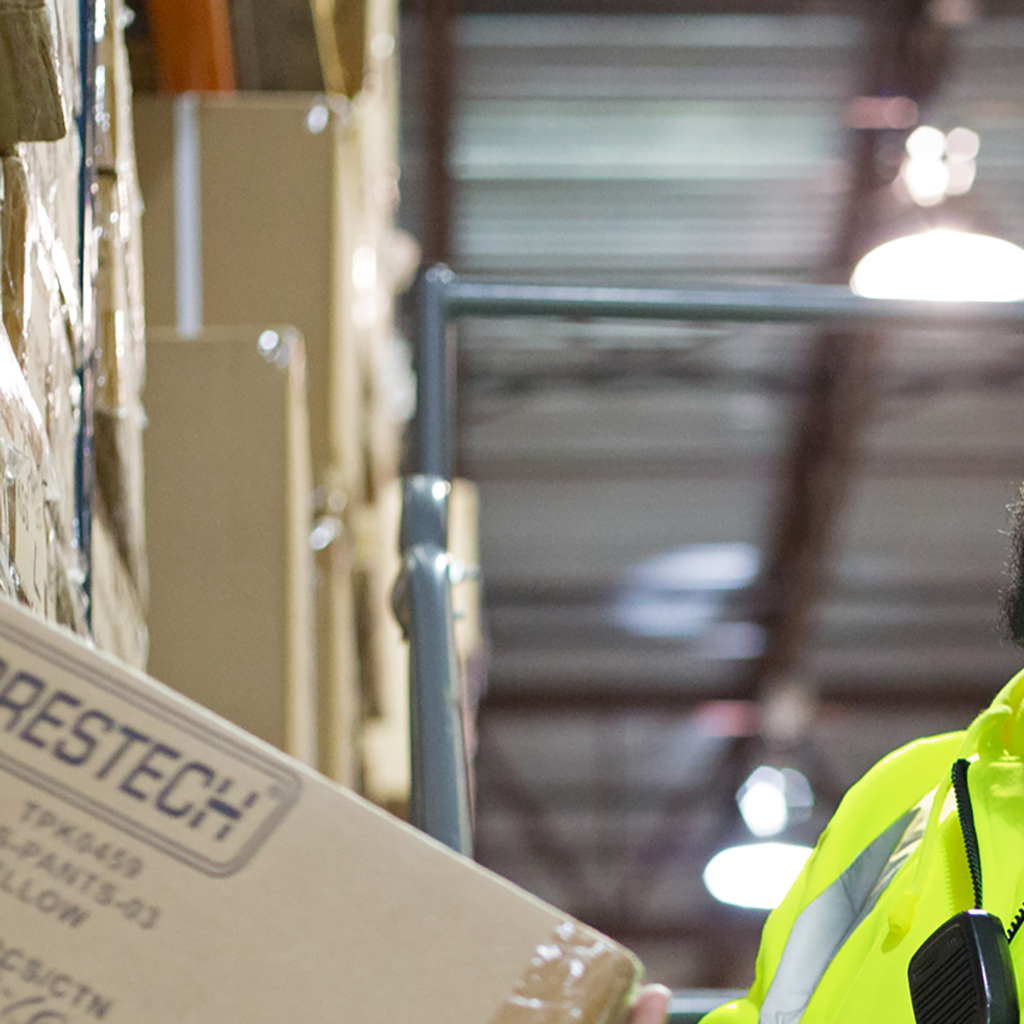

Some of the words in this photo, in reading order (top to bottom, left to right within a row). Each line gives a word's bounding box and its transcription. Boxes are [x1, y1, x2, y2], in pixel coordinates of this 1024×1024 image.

[0, 656, 259, 841] RESTECH
[0, 864, 89, 928] LLOW
[0, 940, 112, 1019] CS/CTN
